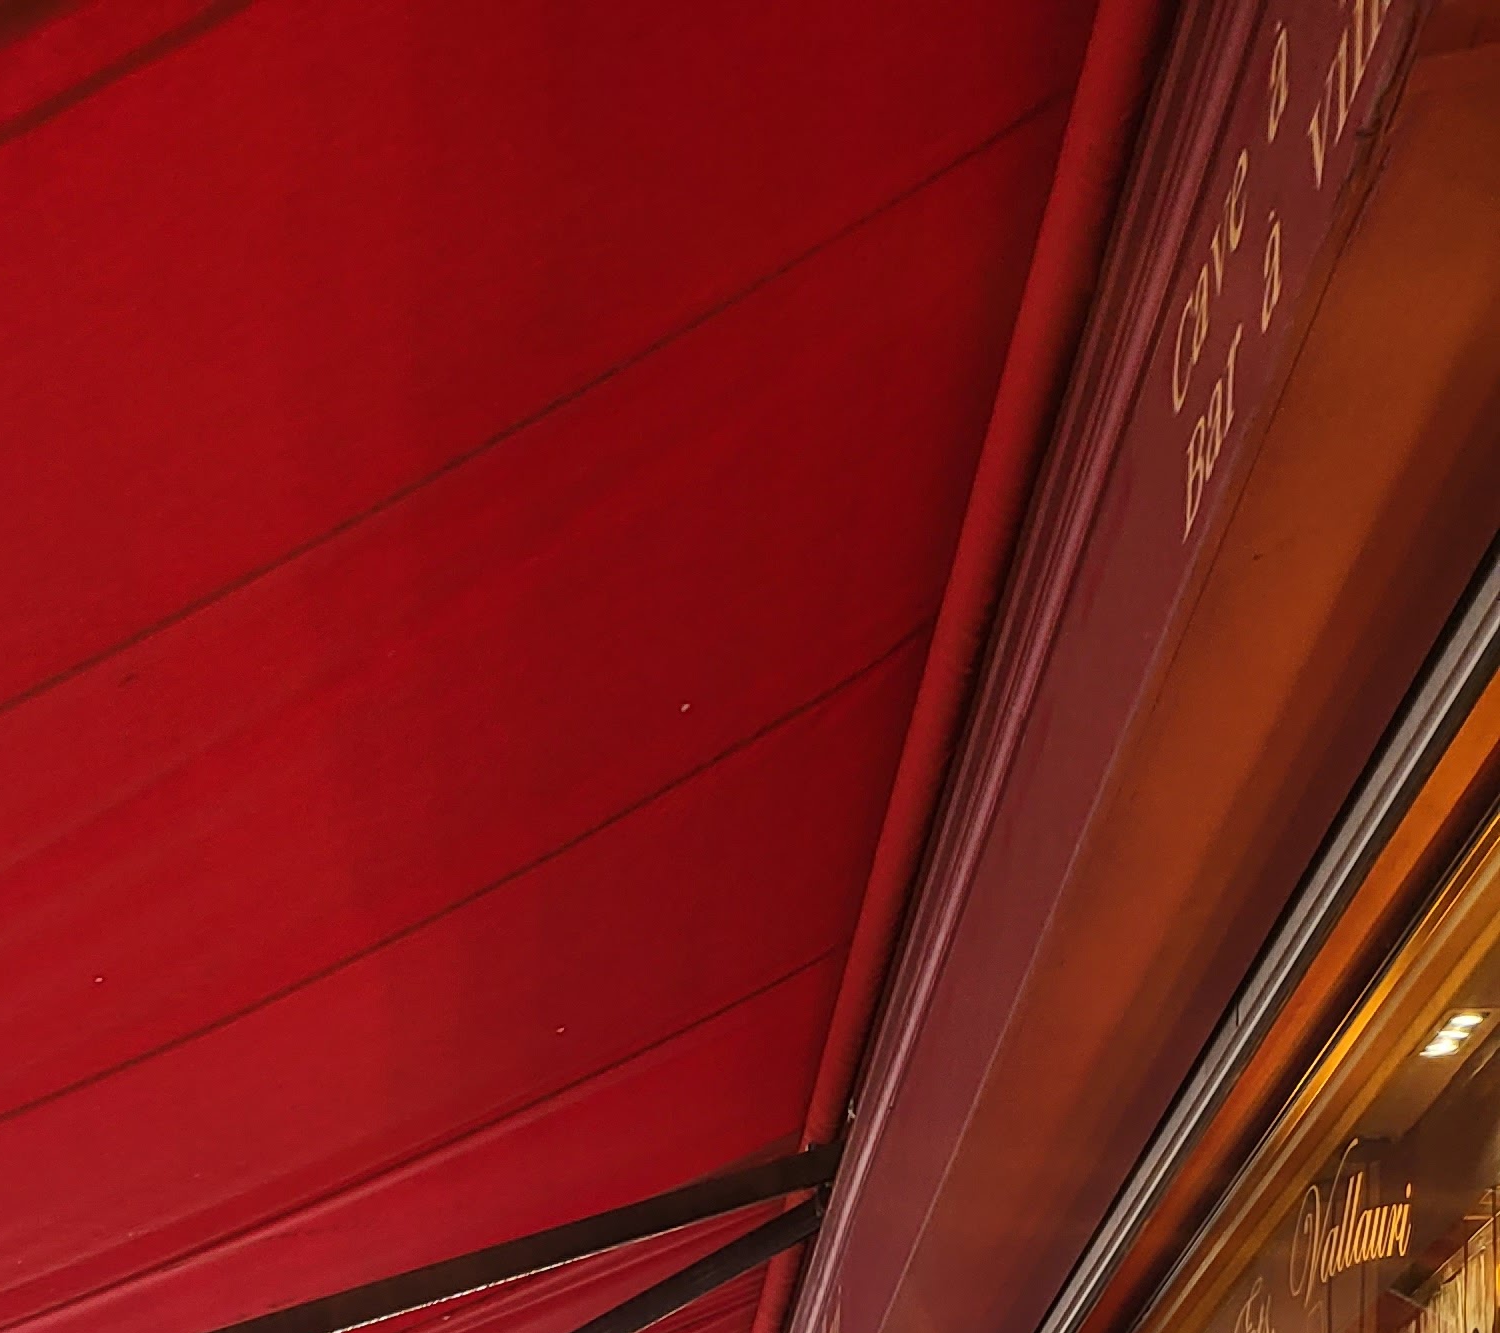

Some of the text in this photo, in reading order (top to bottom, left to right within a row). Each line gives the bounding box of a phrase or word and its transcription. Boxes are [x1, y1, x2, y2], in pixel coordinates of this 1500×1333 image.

[1174, 149, 1248, 414] Cave
[1182, 324, 1242, 543] Bar
[1289, 1137, 1412, 1307] Vallauri
